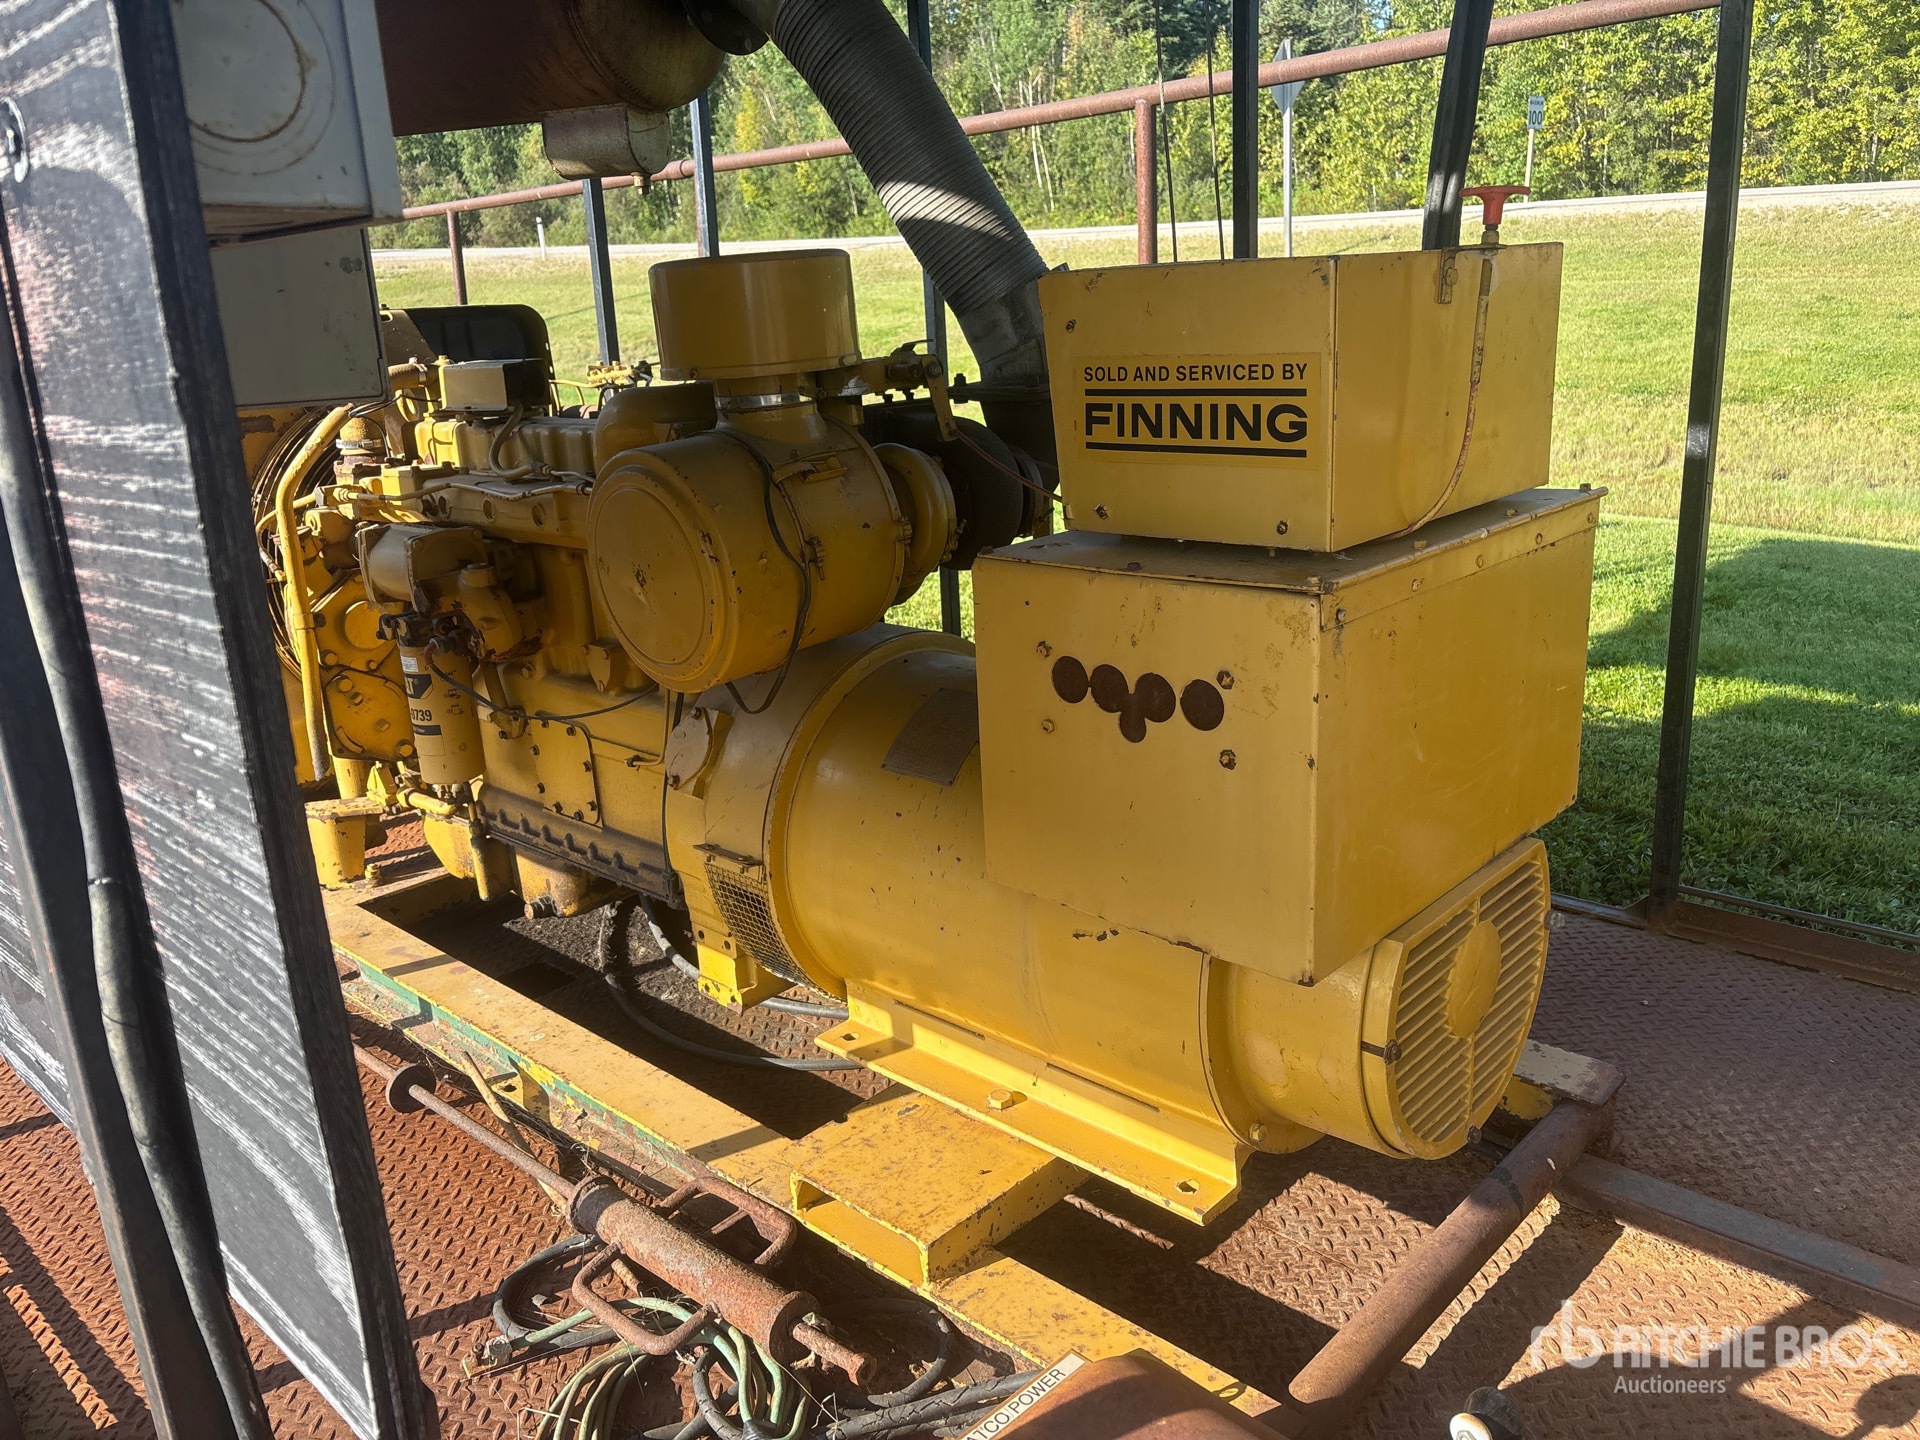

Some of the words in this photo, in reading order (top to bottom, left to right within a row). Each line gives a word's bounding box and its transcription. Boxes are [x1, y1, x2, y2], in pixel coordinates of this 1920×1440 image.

[1528, 109, 1543, 126] 100
[1083, 366, 1128, 382] SOLD
[1133, 365, 1170, 382] AND
[1175, 363, 1275, 382] SERVICED
[1282, 363, 1308, 381] BY
[1085, 402, 1308, 443] FINNING
